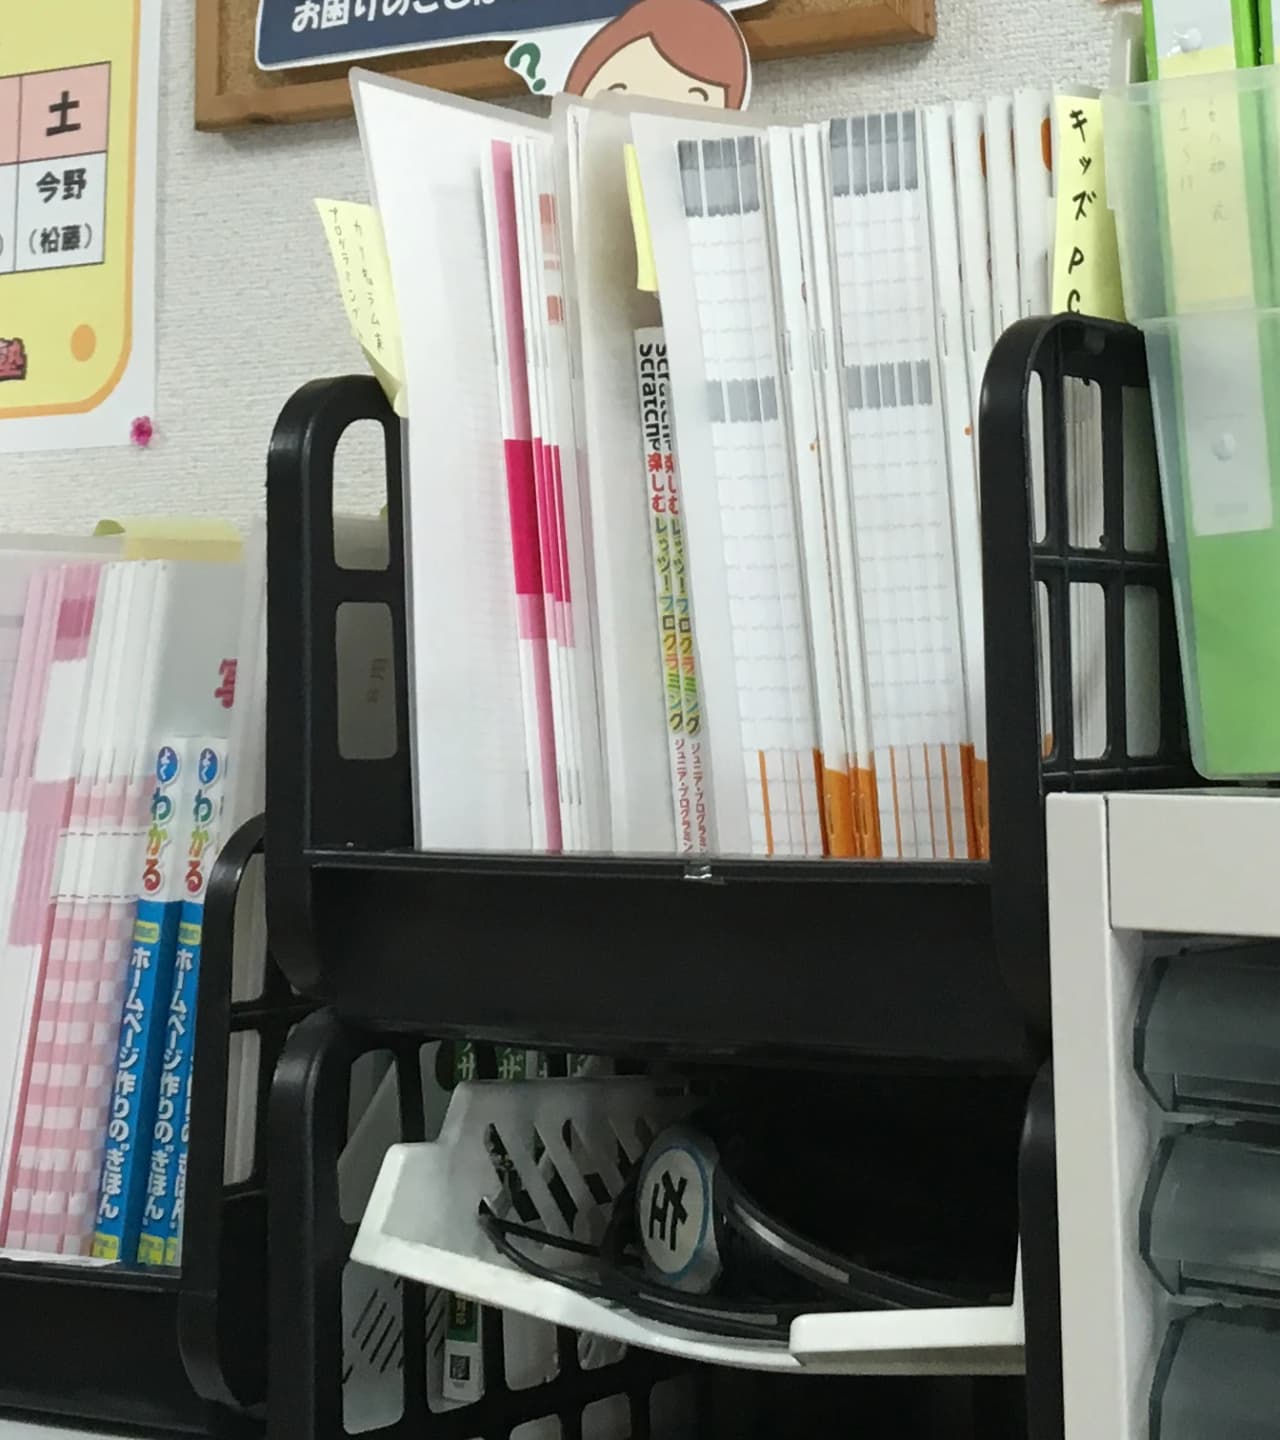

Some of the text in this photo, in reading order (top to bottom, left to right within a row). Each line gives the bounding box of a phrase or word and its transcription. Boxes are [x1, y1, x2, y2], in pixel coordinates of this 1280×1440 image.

[45, 91, 82, 137] 土
[36, 167, 87, 203] 今野
[1069, 109, 1098, 221] キッズ
